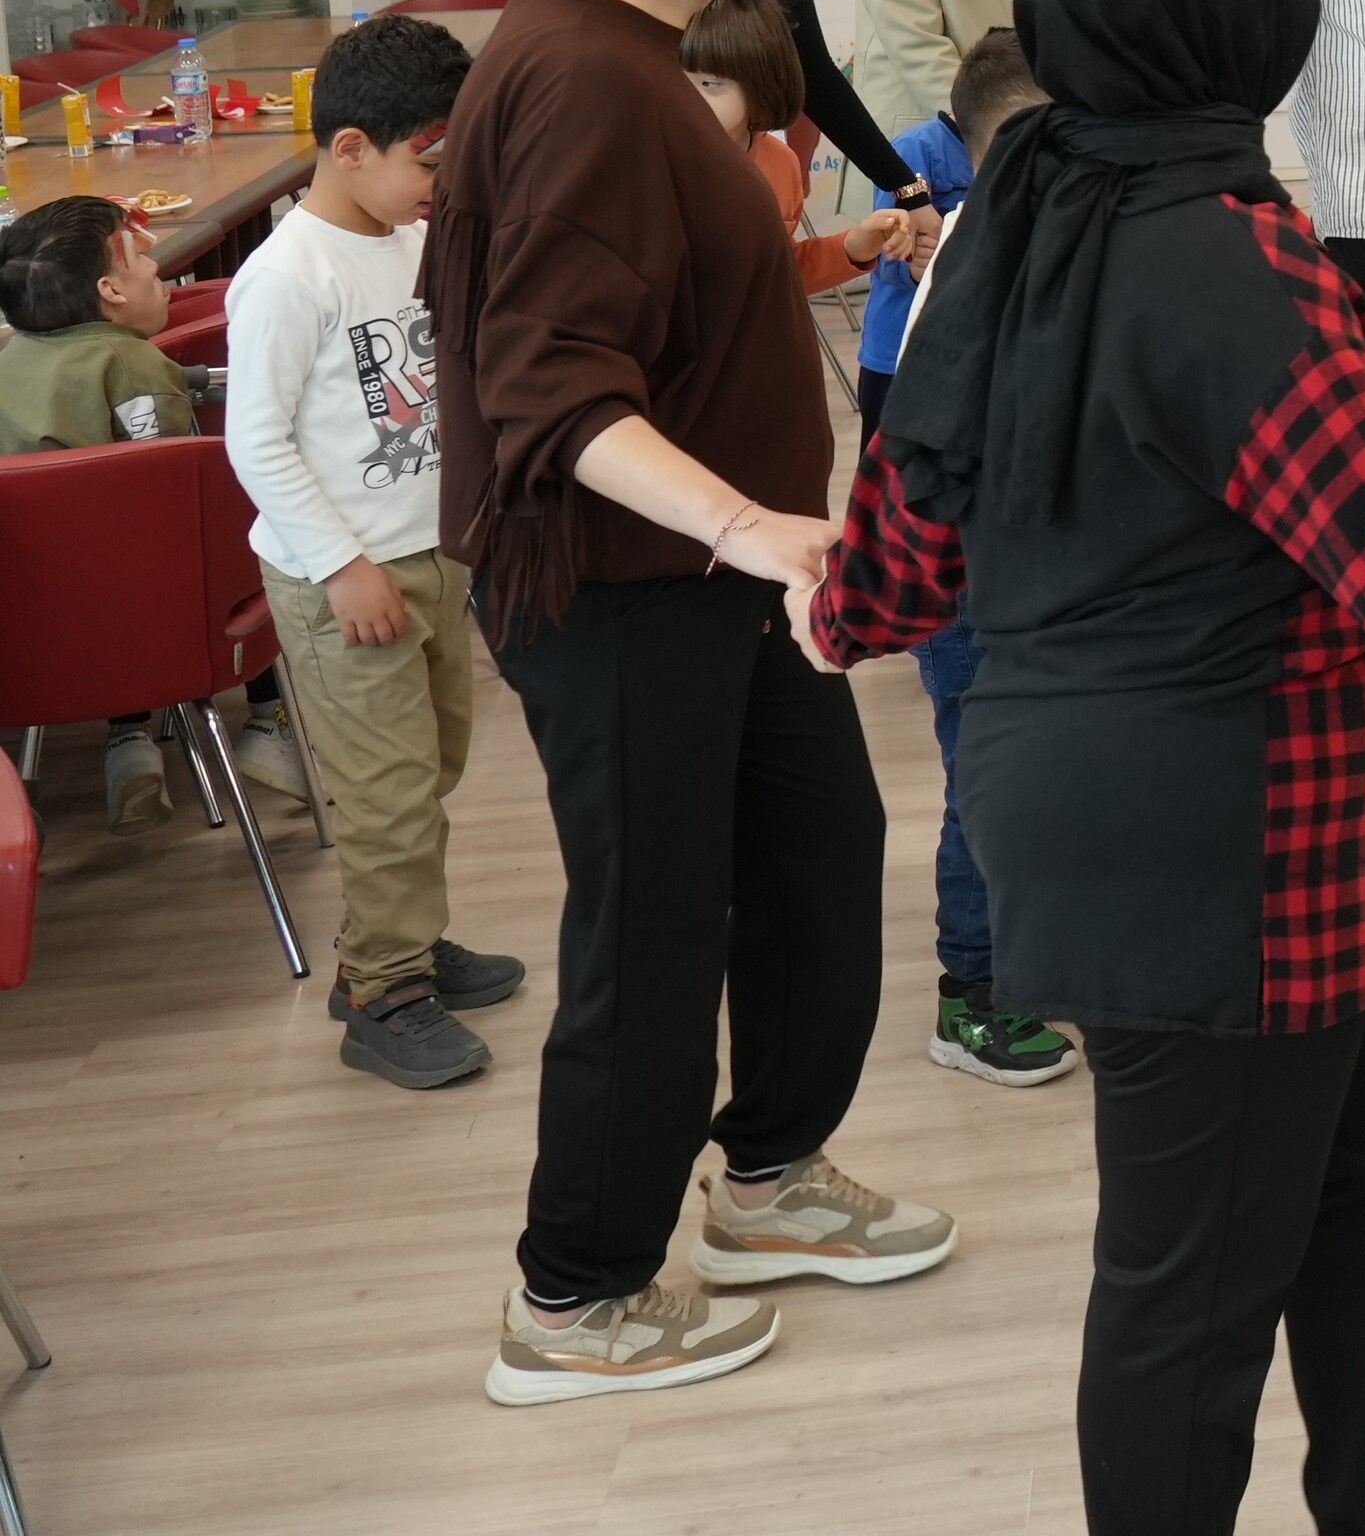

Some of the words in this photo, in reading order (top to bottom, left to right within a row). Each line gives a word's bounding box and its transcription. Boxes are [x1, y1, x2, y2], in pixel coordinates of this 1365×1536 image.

[351, 327, 372, 371] SINCE
[361, 372, 387, 414] 1980
[383, 436, 406, 458] NYC
